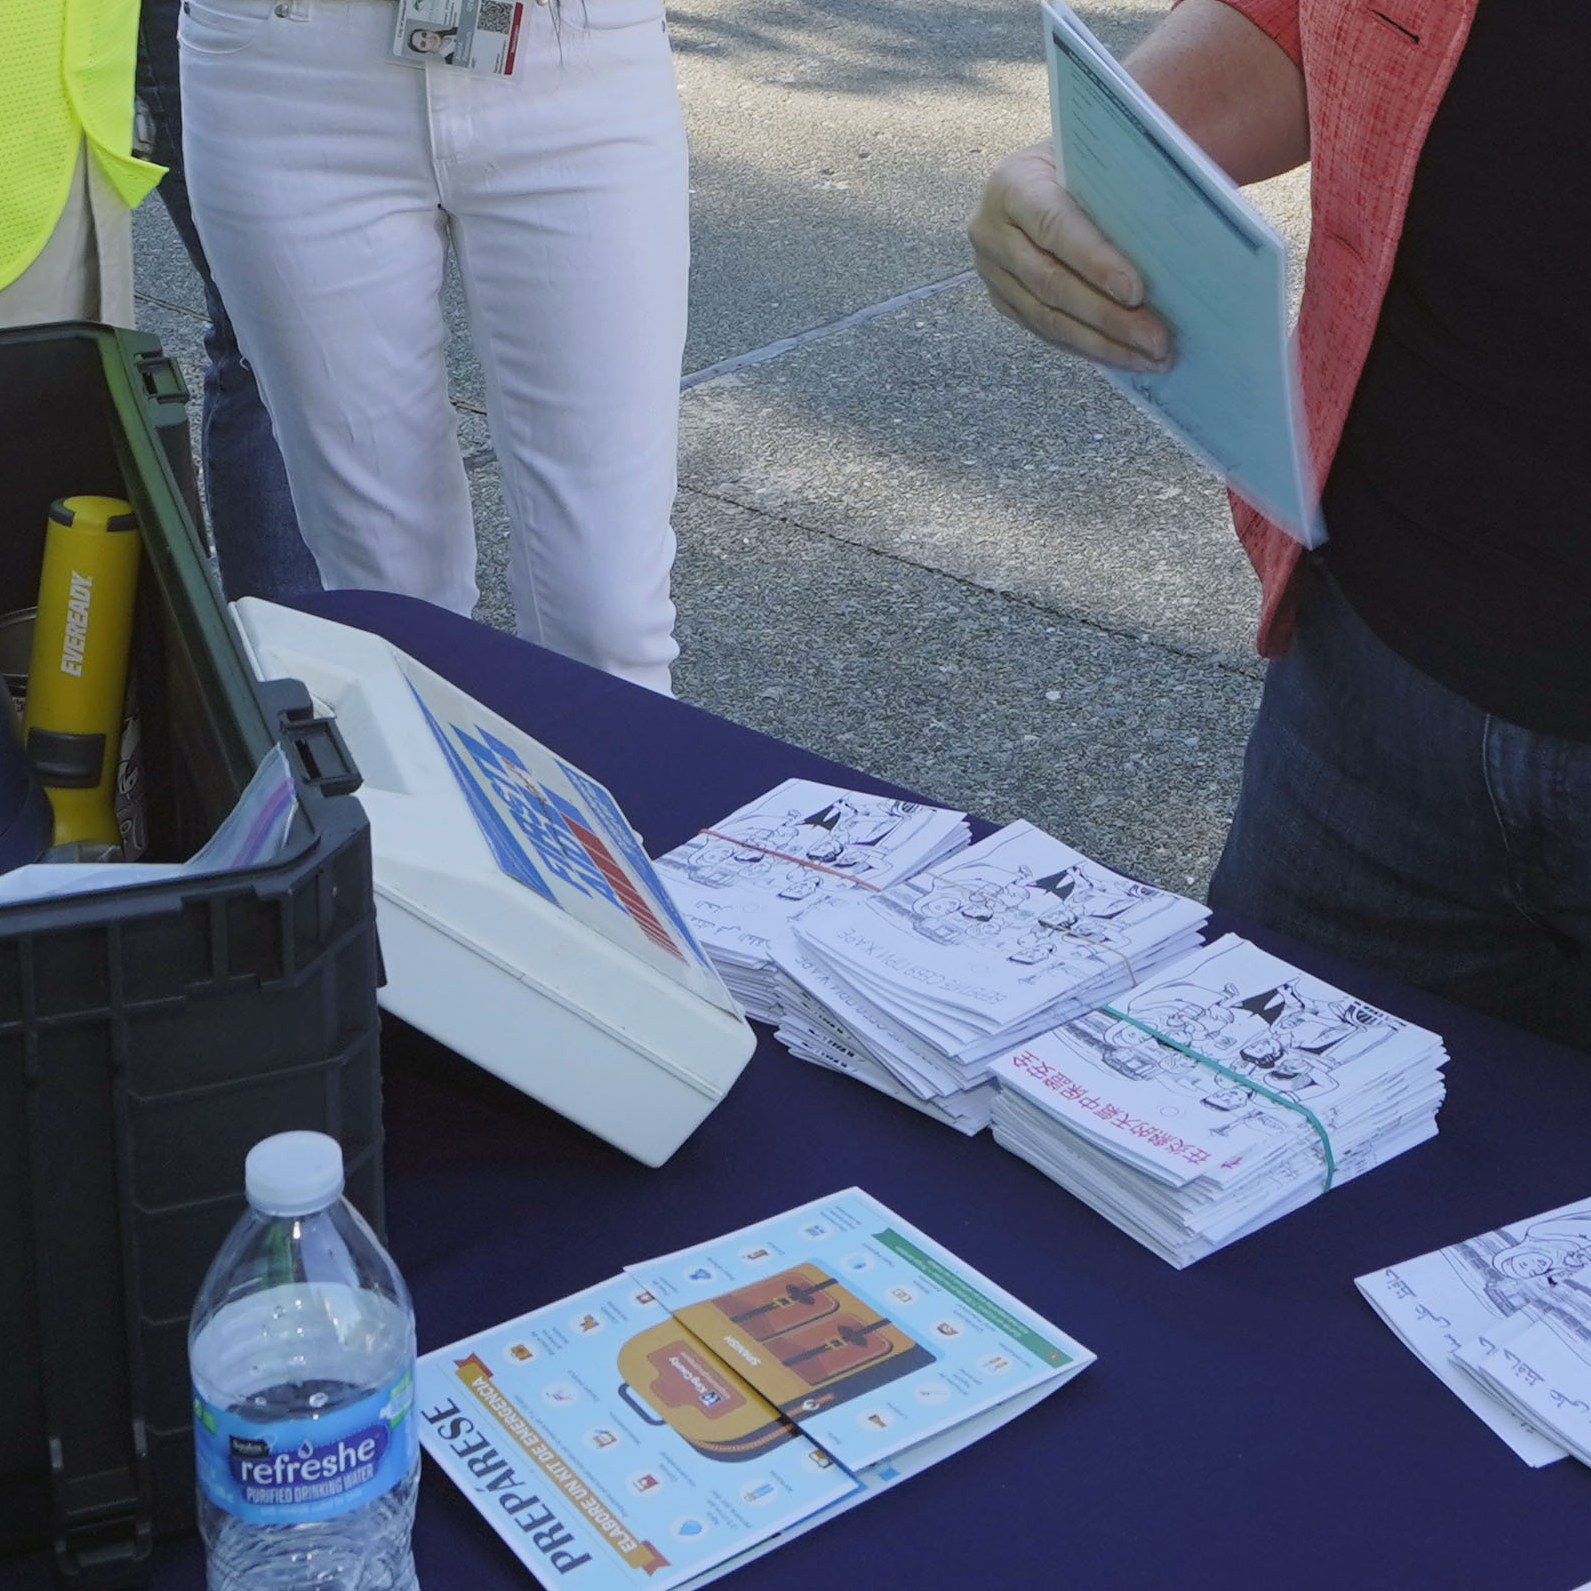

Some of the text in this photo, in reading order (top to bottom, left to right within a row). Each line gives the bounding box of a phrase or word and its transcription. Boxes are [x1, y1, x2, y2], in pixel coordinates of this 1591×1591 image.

[60, 569, 93, 678] EVEREADY
[241, 1437, 377, 1484] refreshe
[246, 1463, 375, 1504] PURIFIED DRINKING WATER
[421, 1397, 593, 1575] PREPÁRESE
[471, 1376, 638, 1554] ELABORE UN KIT DE EMERGENCIA
